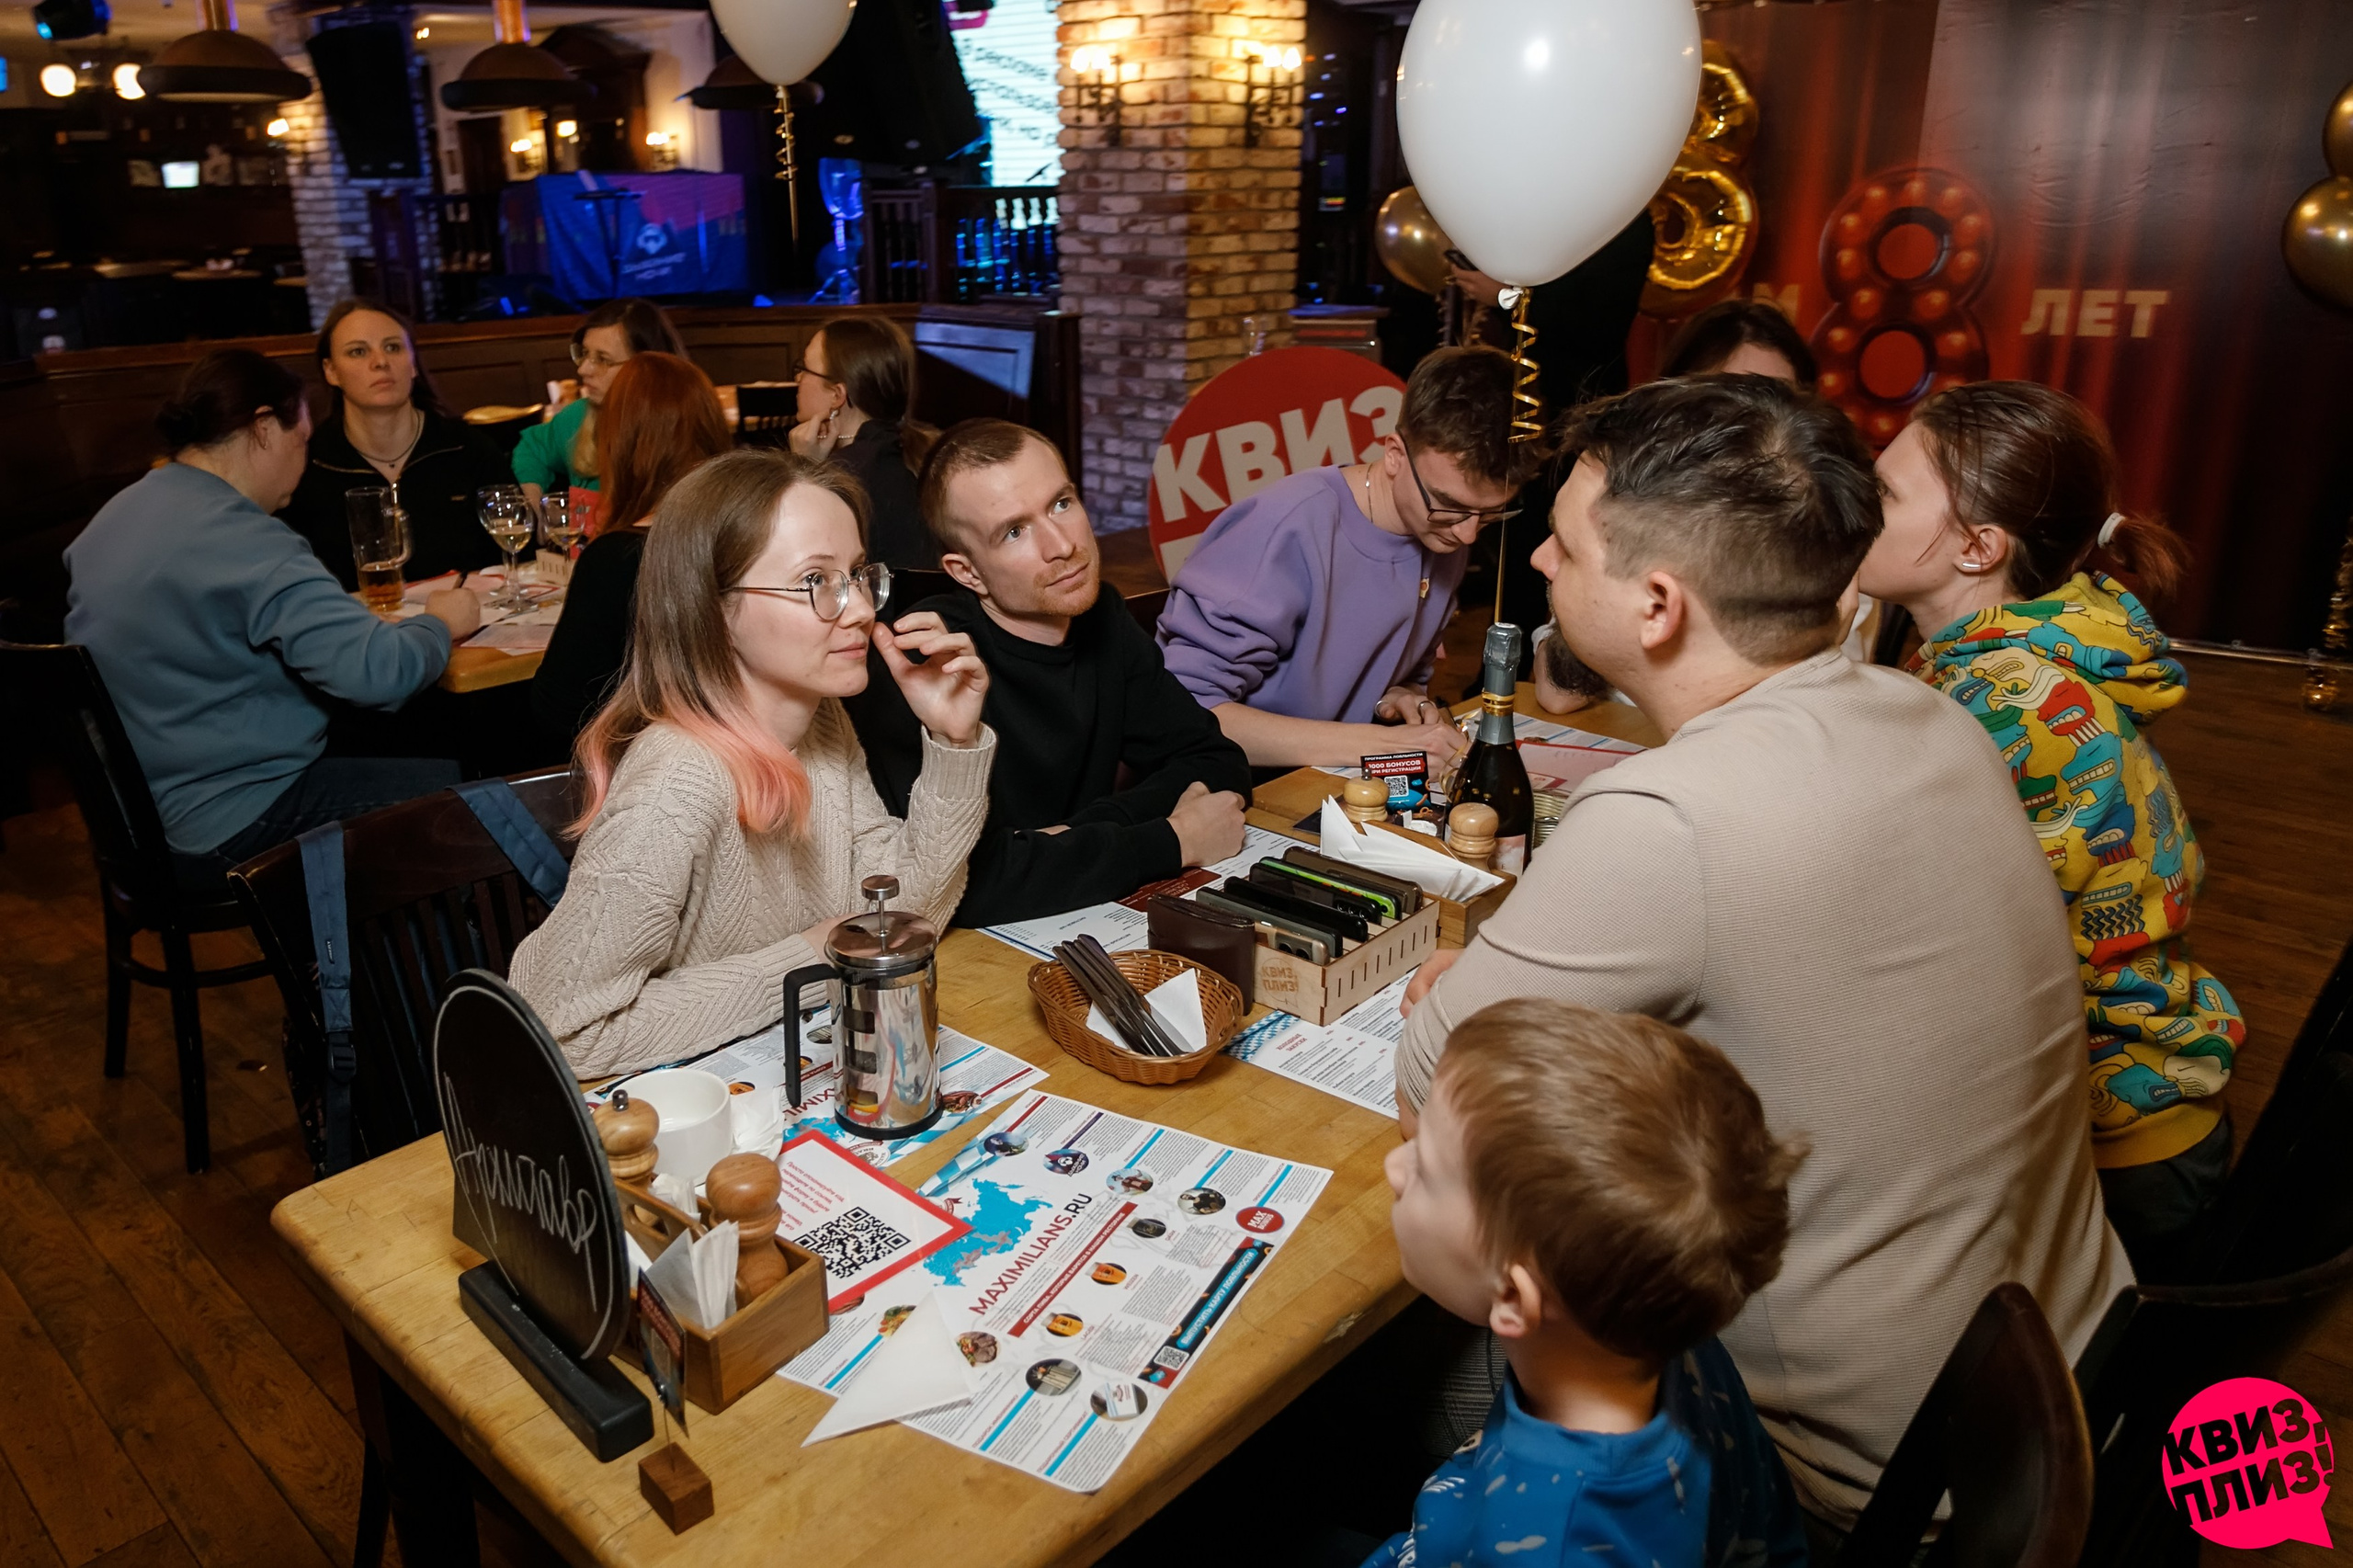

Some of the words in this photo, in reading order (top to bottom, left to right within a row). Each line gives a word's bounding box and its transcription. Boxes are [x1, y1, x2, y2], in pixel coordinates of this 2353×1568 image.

[2020, 289, 2171, 338] ЛЕТ
[1247, 1210, 1267, 1228] MAX
[966, 1192, 1094, 1315] MAXIMILIANS.RU
[1021, 1307, 1040, 1323] СОРТА
[1049, 1273, 1072, 1294] КОТОРЫЕ
[1179, 1307, 1213, 1344] ВЫПУСТИТЬ
[1207, 1288, 1228, 1308] КАРТУ
[1221, 1250, 1256, 1290] ЛОЯЛЬНОСТИ
